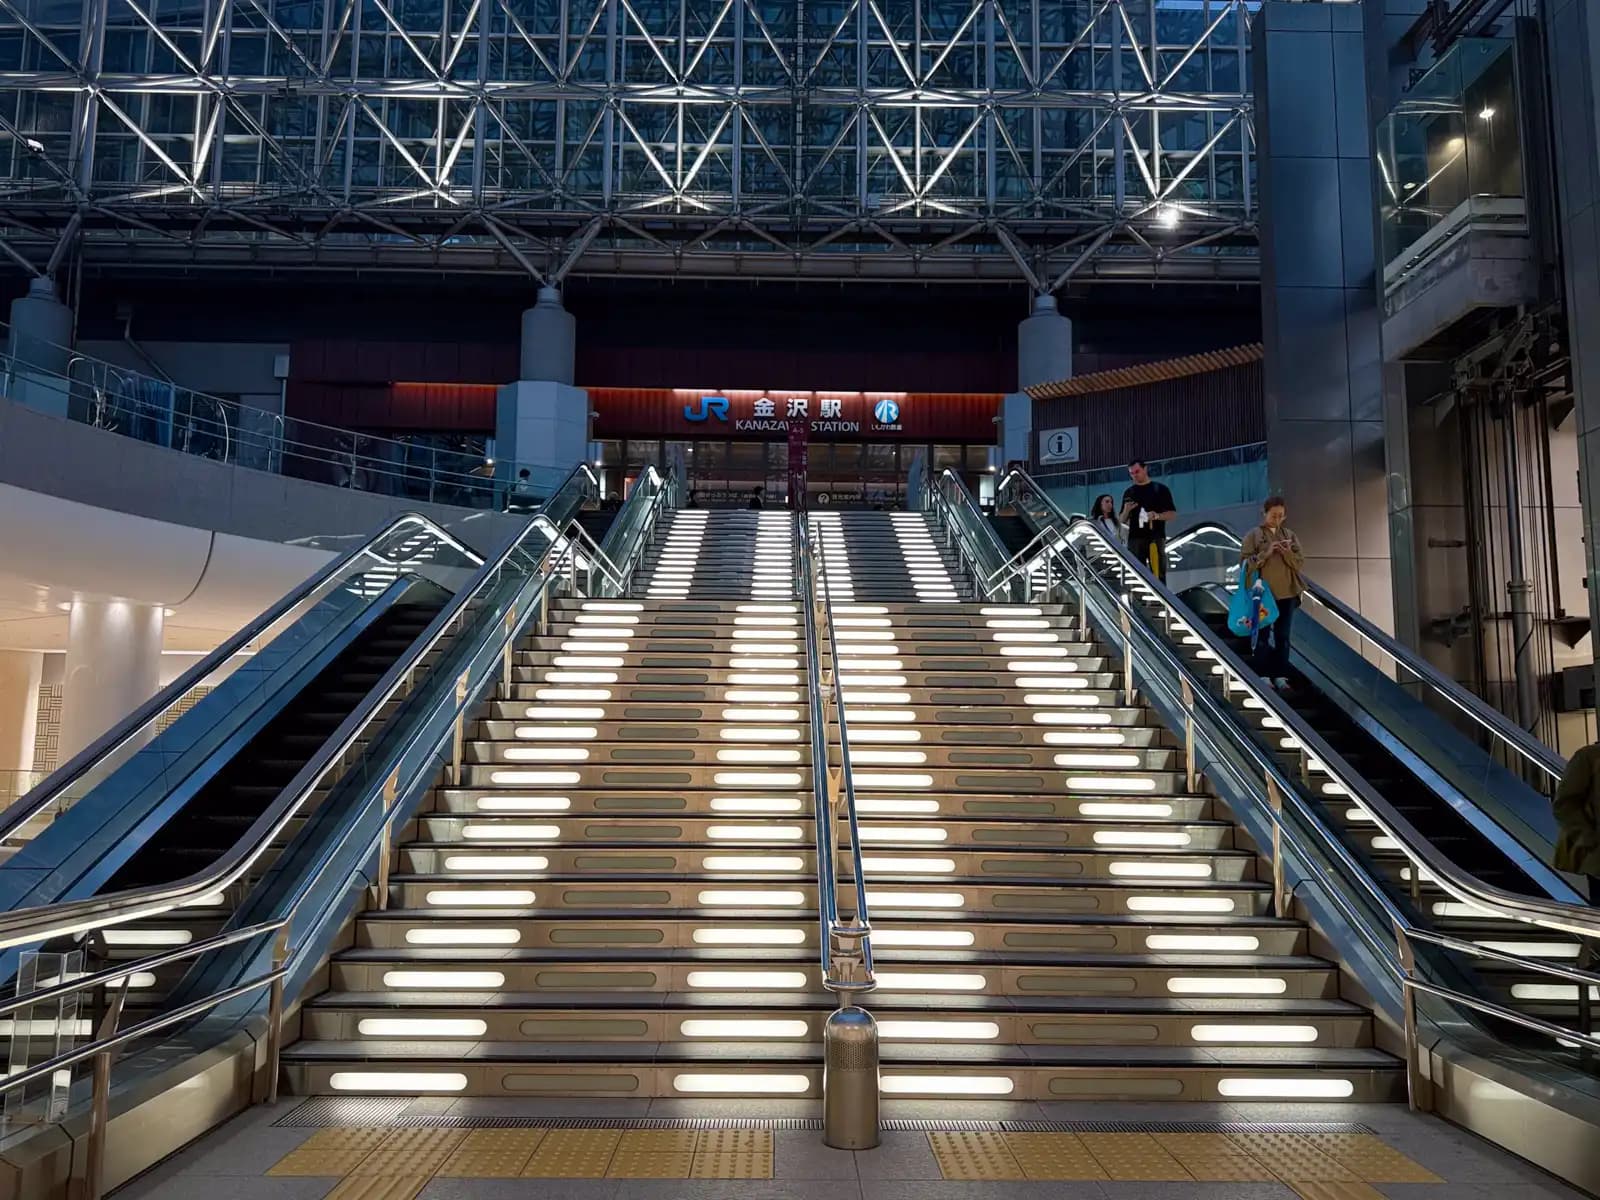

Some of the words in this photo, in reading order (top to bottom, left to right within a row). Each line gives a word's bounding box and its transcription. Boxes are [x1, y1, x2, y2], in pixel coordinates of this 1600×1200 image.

[684, 396, 730, 421] JR
[753, 397, 842, 417] 金沢駅
[735, 420, 789, 432] KANAZA
[810, 421, 860, 432] STATION
